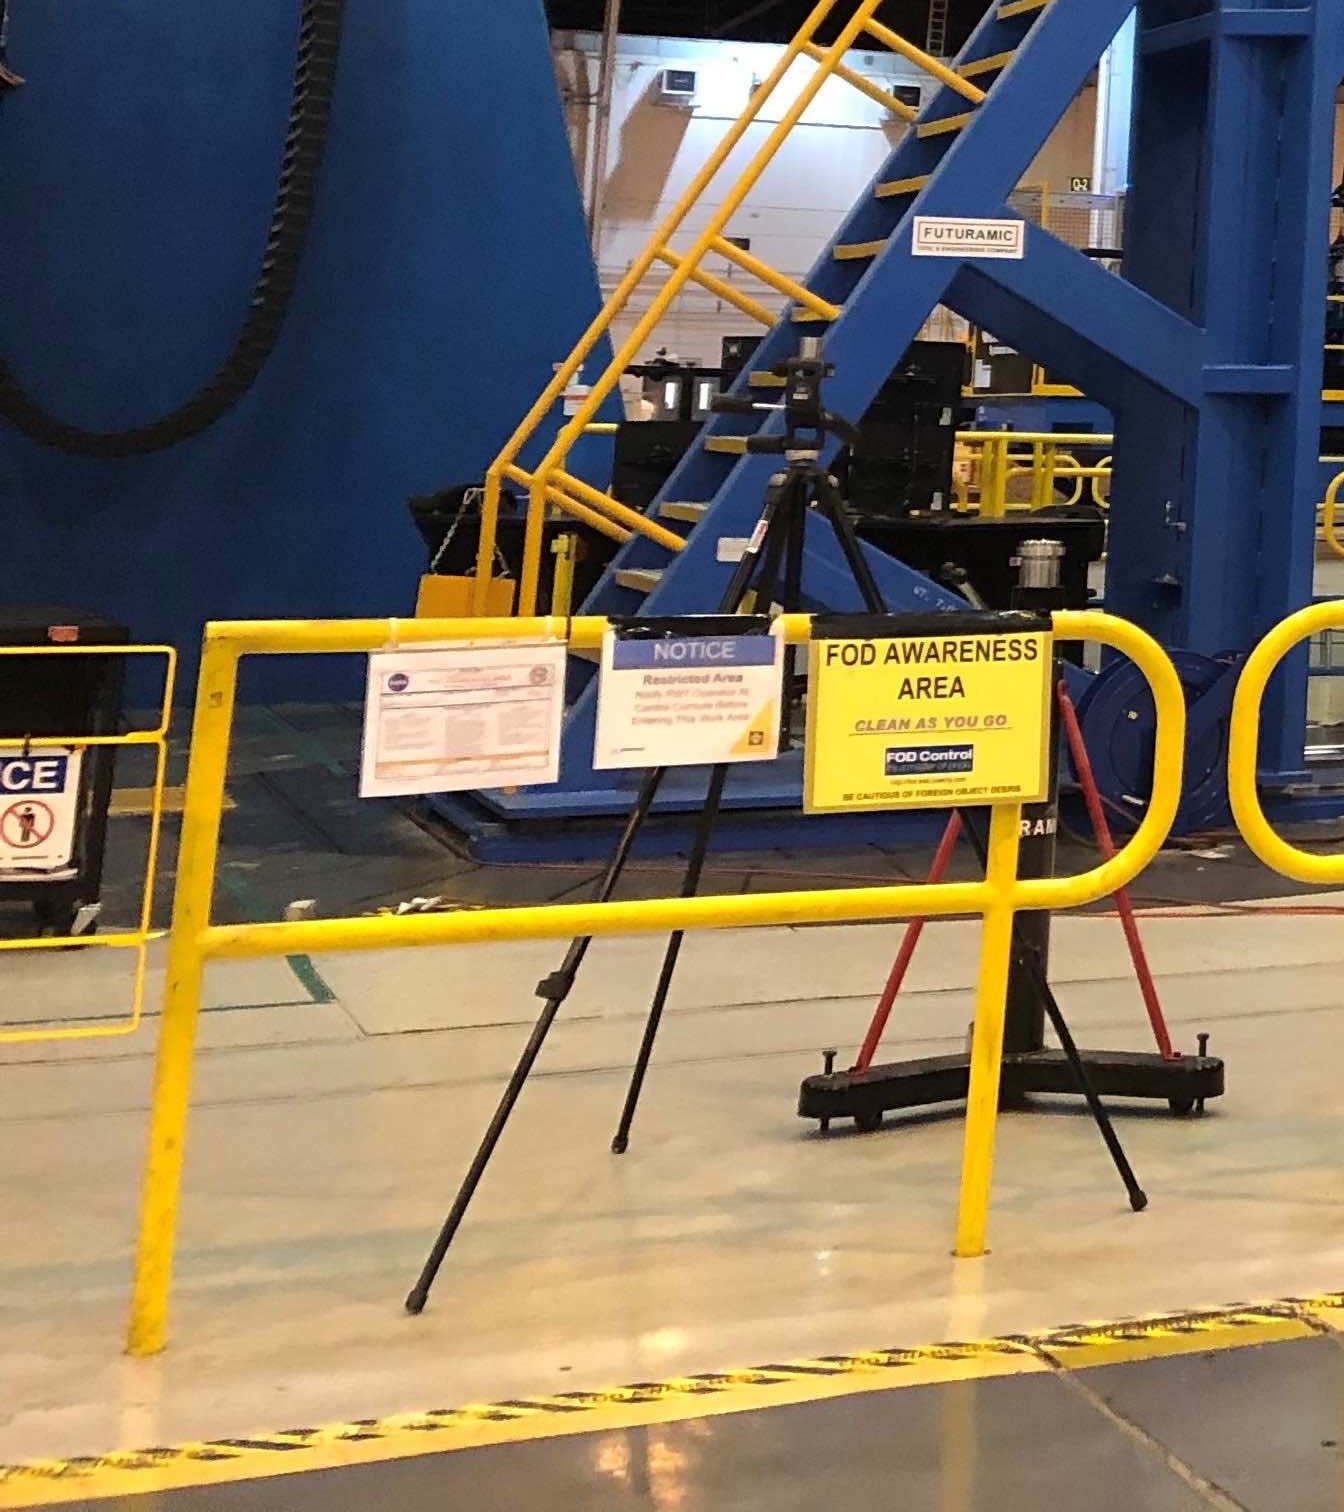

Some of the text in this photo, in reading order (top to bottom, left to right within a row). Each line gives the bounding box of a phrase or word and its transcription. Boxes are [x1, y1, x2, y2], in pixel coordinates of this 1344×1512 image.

[924, 228, 1013, 241] FUTURAMIC
[653, 641, 737, 661] NOTICE
[826, 638, 1038, 666] FOD AWARENESS
[643, 673, 743, 686] Restricted Area
[897, 676, 965, 700] AREA
[854, 714, 1007, 732] CLEAN AS YOU GO
[886, 749, 973, 763] FOD Control
[955, 787, 988, 796] OBJECT
